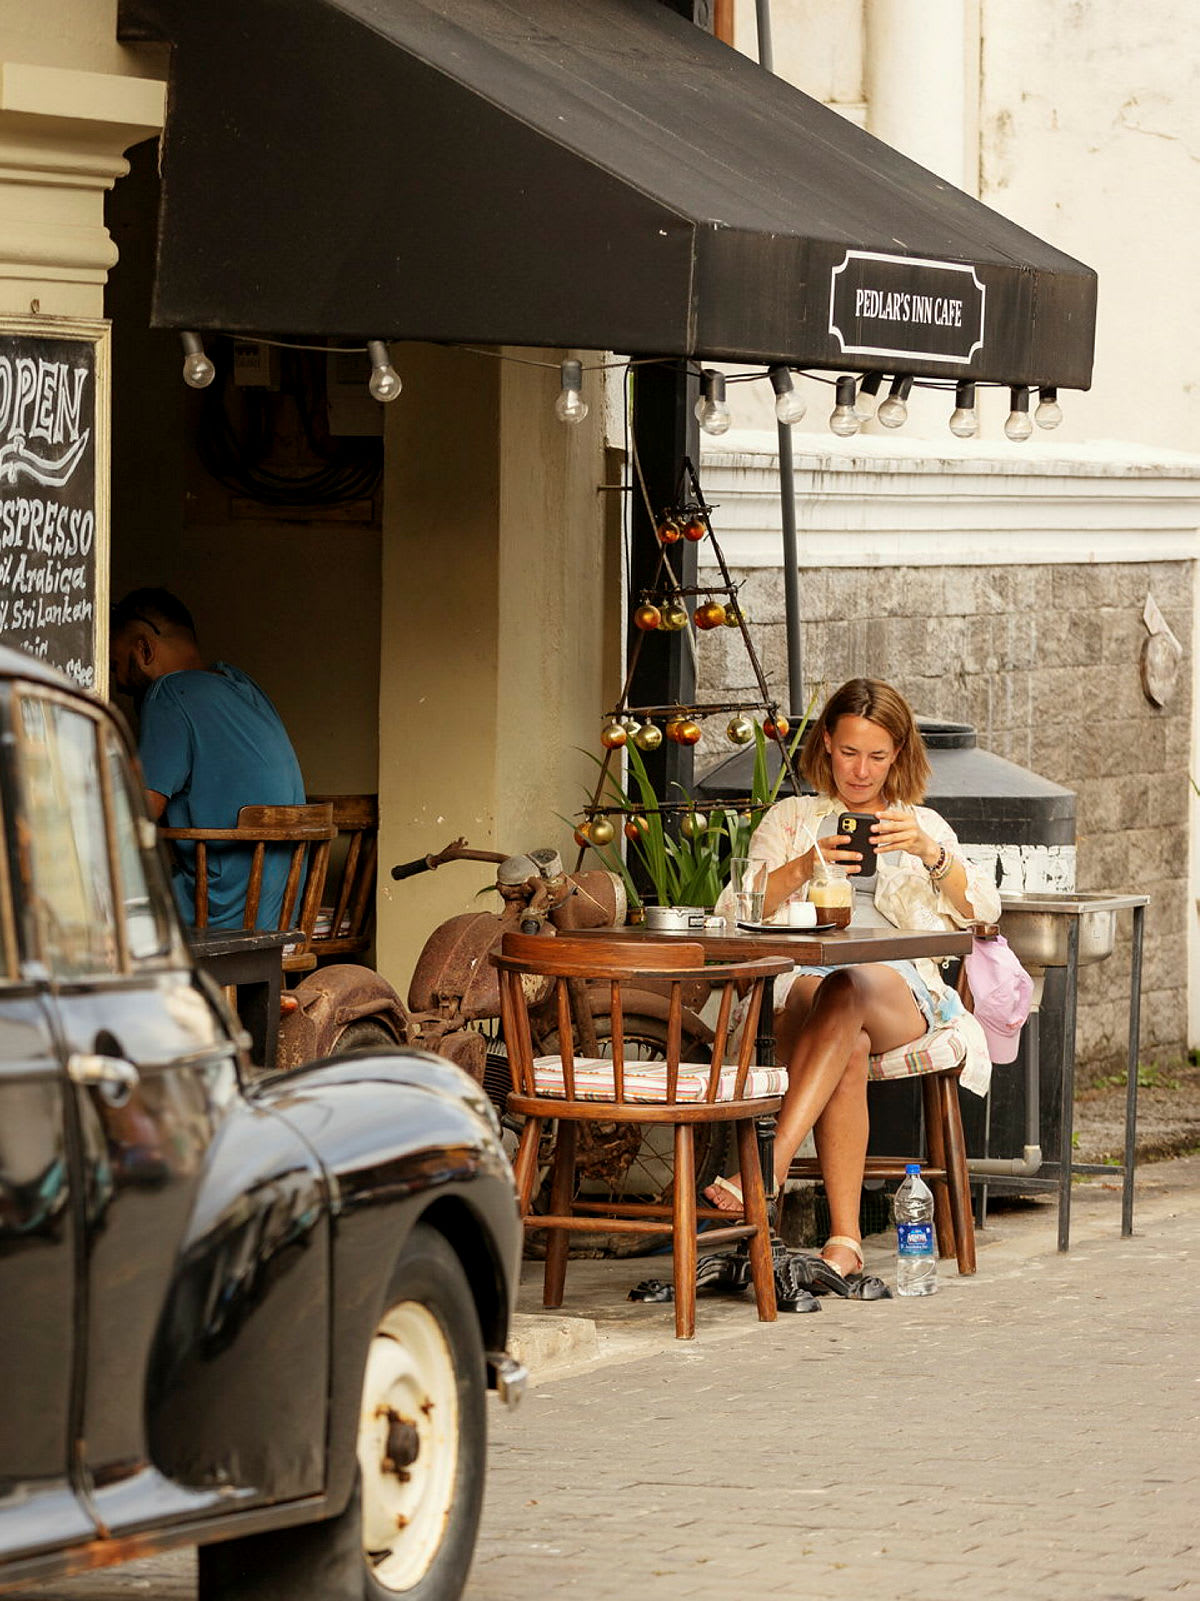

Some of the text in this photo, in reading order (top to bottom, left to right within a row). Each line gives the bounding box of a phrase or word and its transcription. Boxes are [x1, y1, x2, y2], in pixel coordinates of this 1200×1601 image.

[855, 289, 962, 327] PEDLAR'S INN CAFE
[12, 553, 86, 593] Arabica
[11, 599, 35, 629] Sri
[37, 596, 92, 626] Lankan
